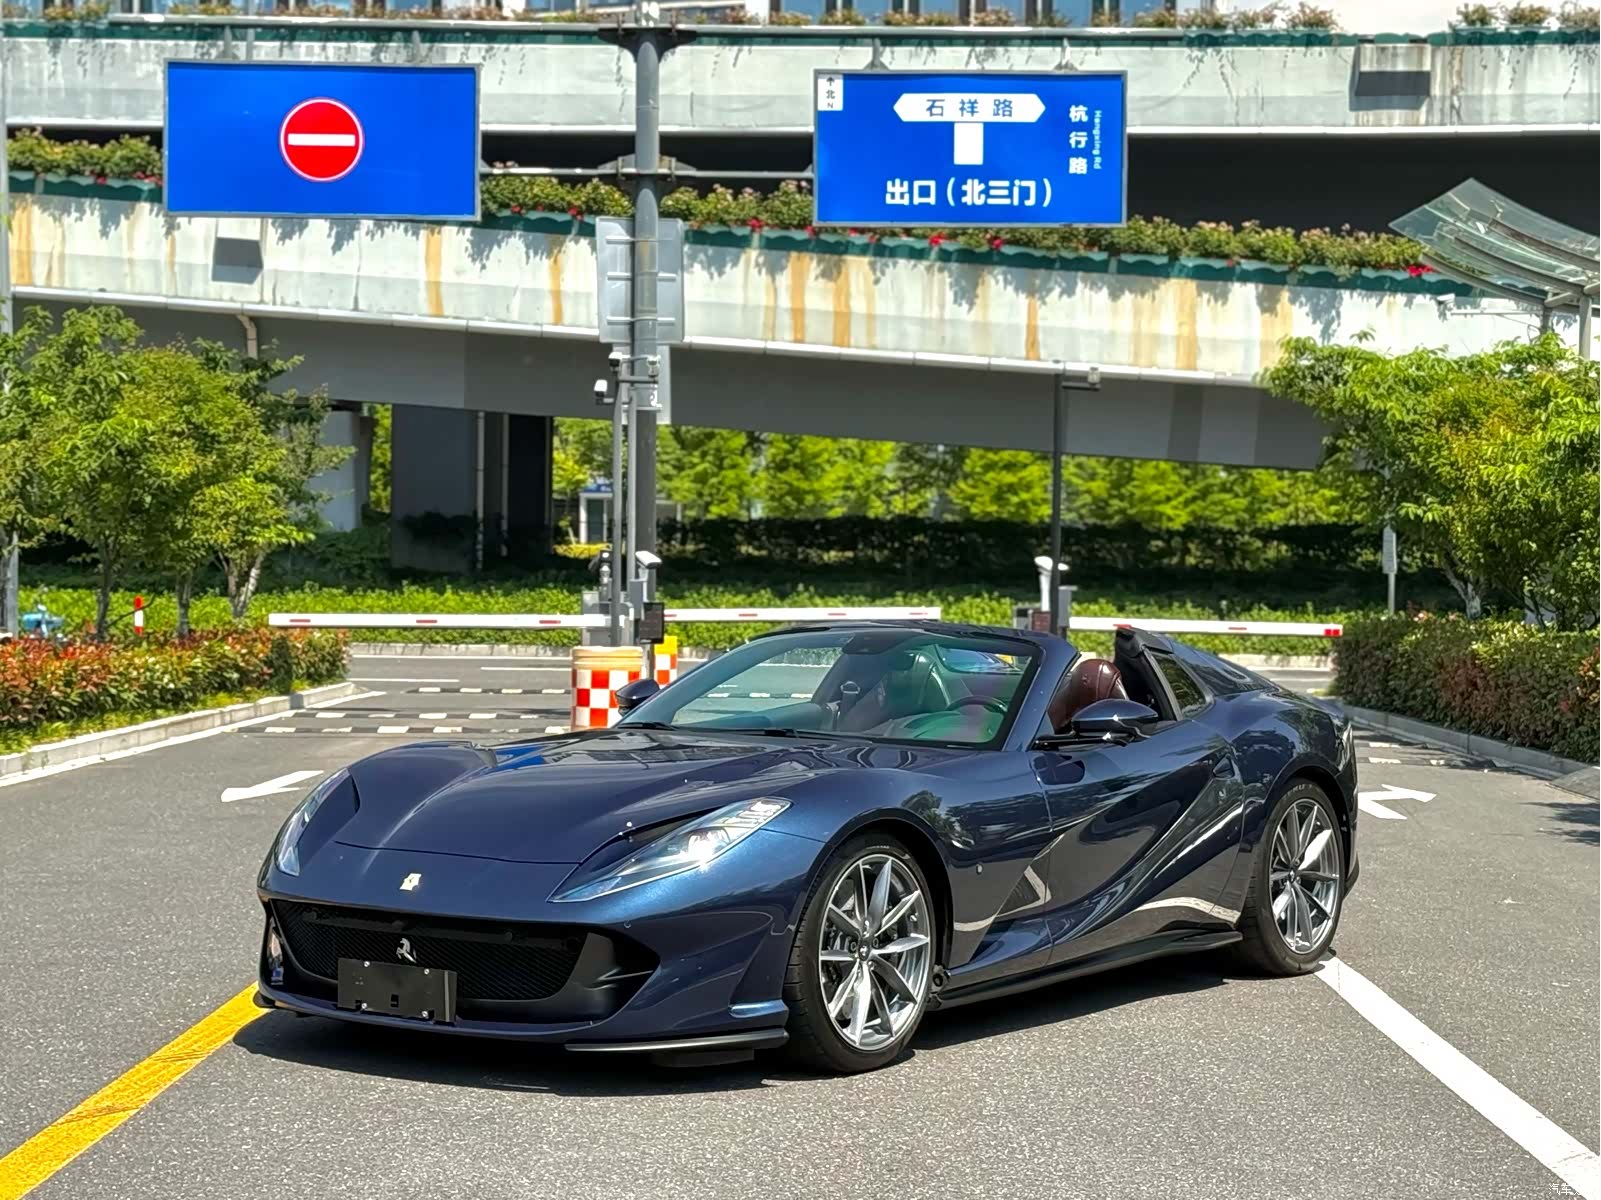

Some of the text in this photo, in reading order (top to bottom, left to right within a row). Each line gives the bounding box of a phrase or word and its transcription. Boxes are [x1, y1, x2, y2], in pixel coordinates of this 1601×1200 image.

[826, 89, 836, 99] 北
[926, 99, 1013, 117] 石祥路
[1069, 104, 1088, 174] 杭行路
[1093, 156, 1102, 169] Rd
